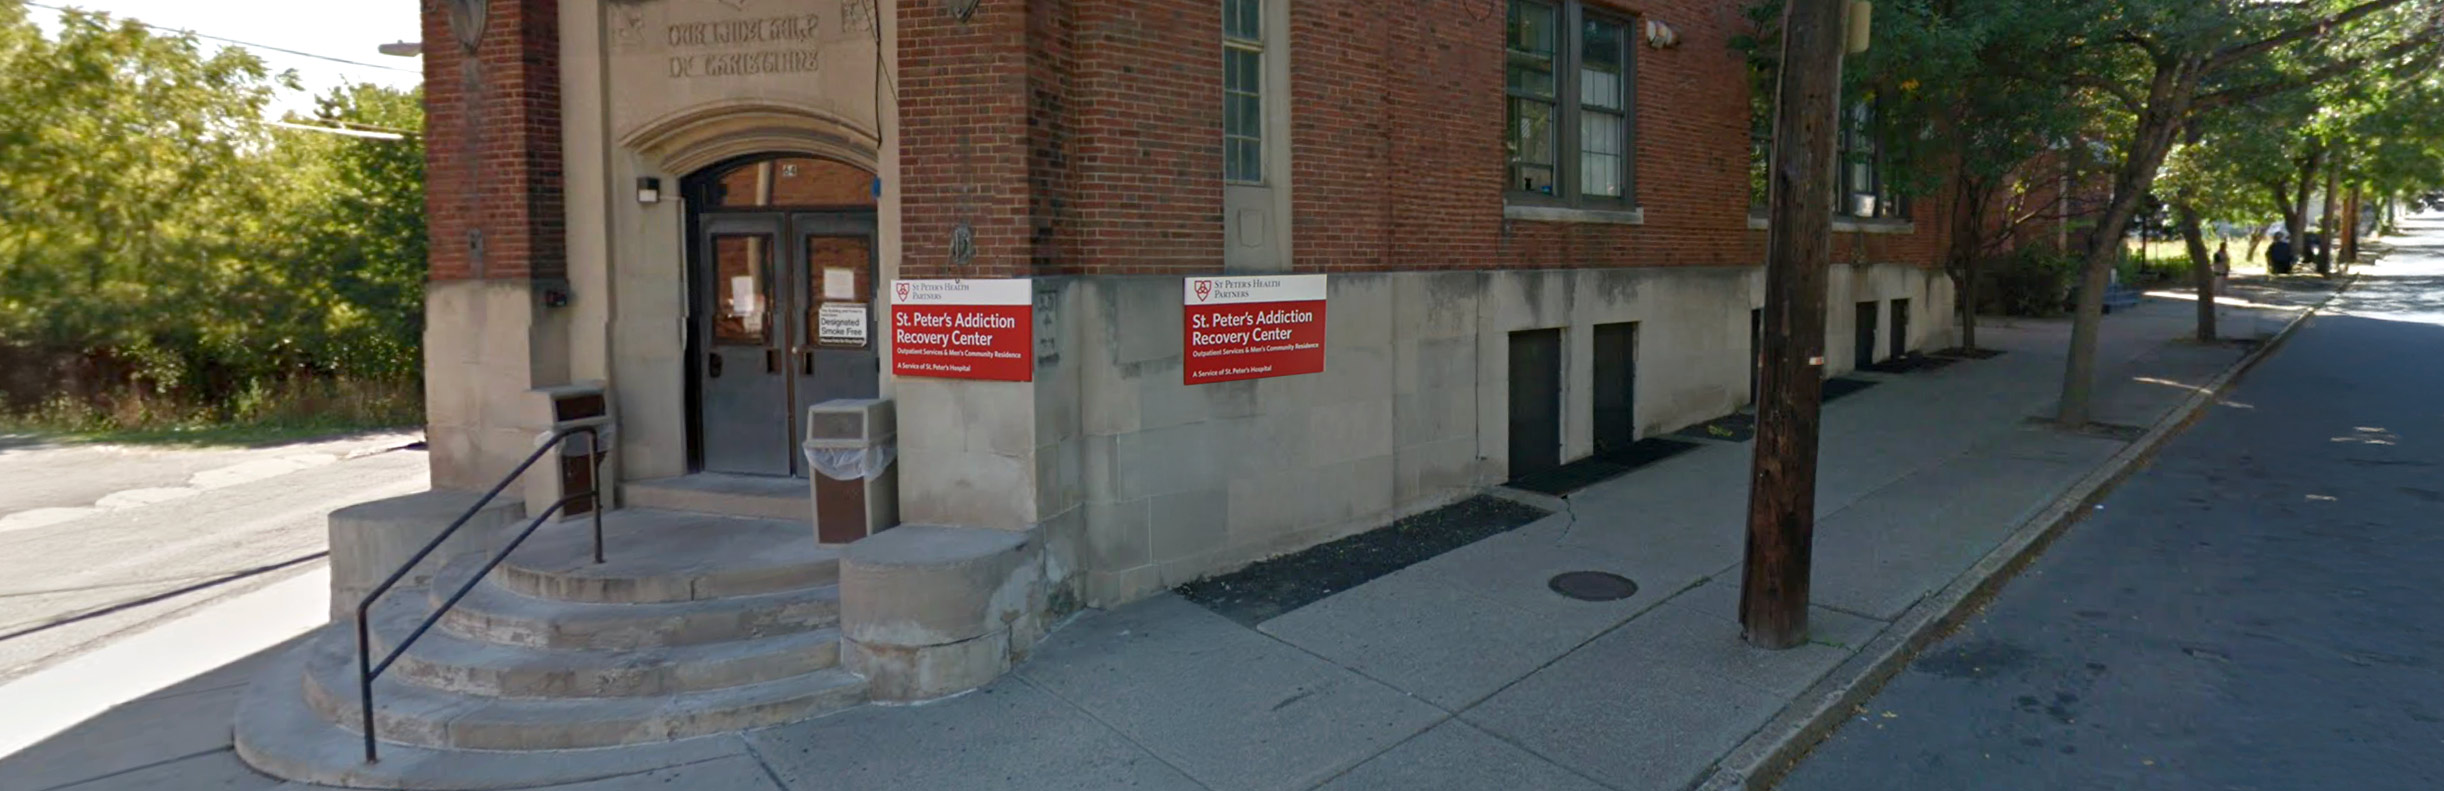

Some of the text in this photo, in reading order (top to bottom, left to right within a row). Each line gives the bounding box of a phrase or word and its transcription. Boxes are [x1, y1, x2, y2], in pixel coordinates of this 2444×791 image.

[821, 318, 860, 327] Designated
[896, 312, 1015, 328] St. Peter's Addiction
[1192, 310, 1313, 328] St. Peter's Addiction
[897, 329, 993, 347] Recovery Center
[1193, 327, 1292, 345] Recovery Center
[897, 347, 922, 356] Outpatient
[965, 350, 994, 358] Community
[1193, 348, 1222, 358] Outpatient
